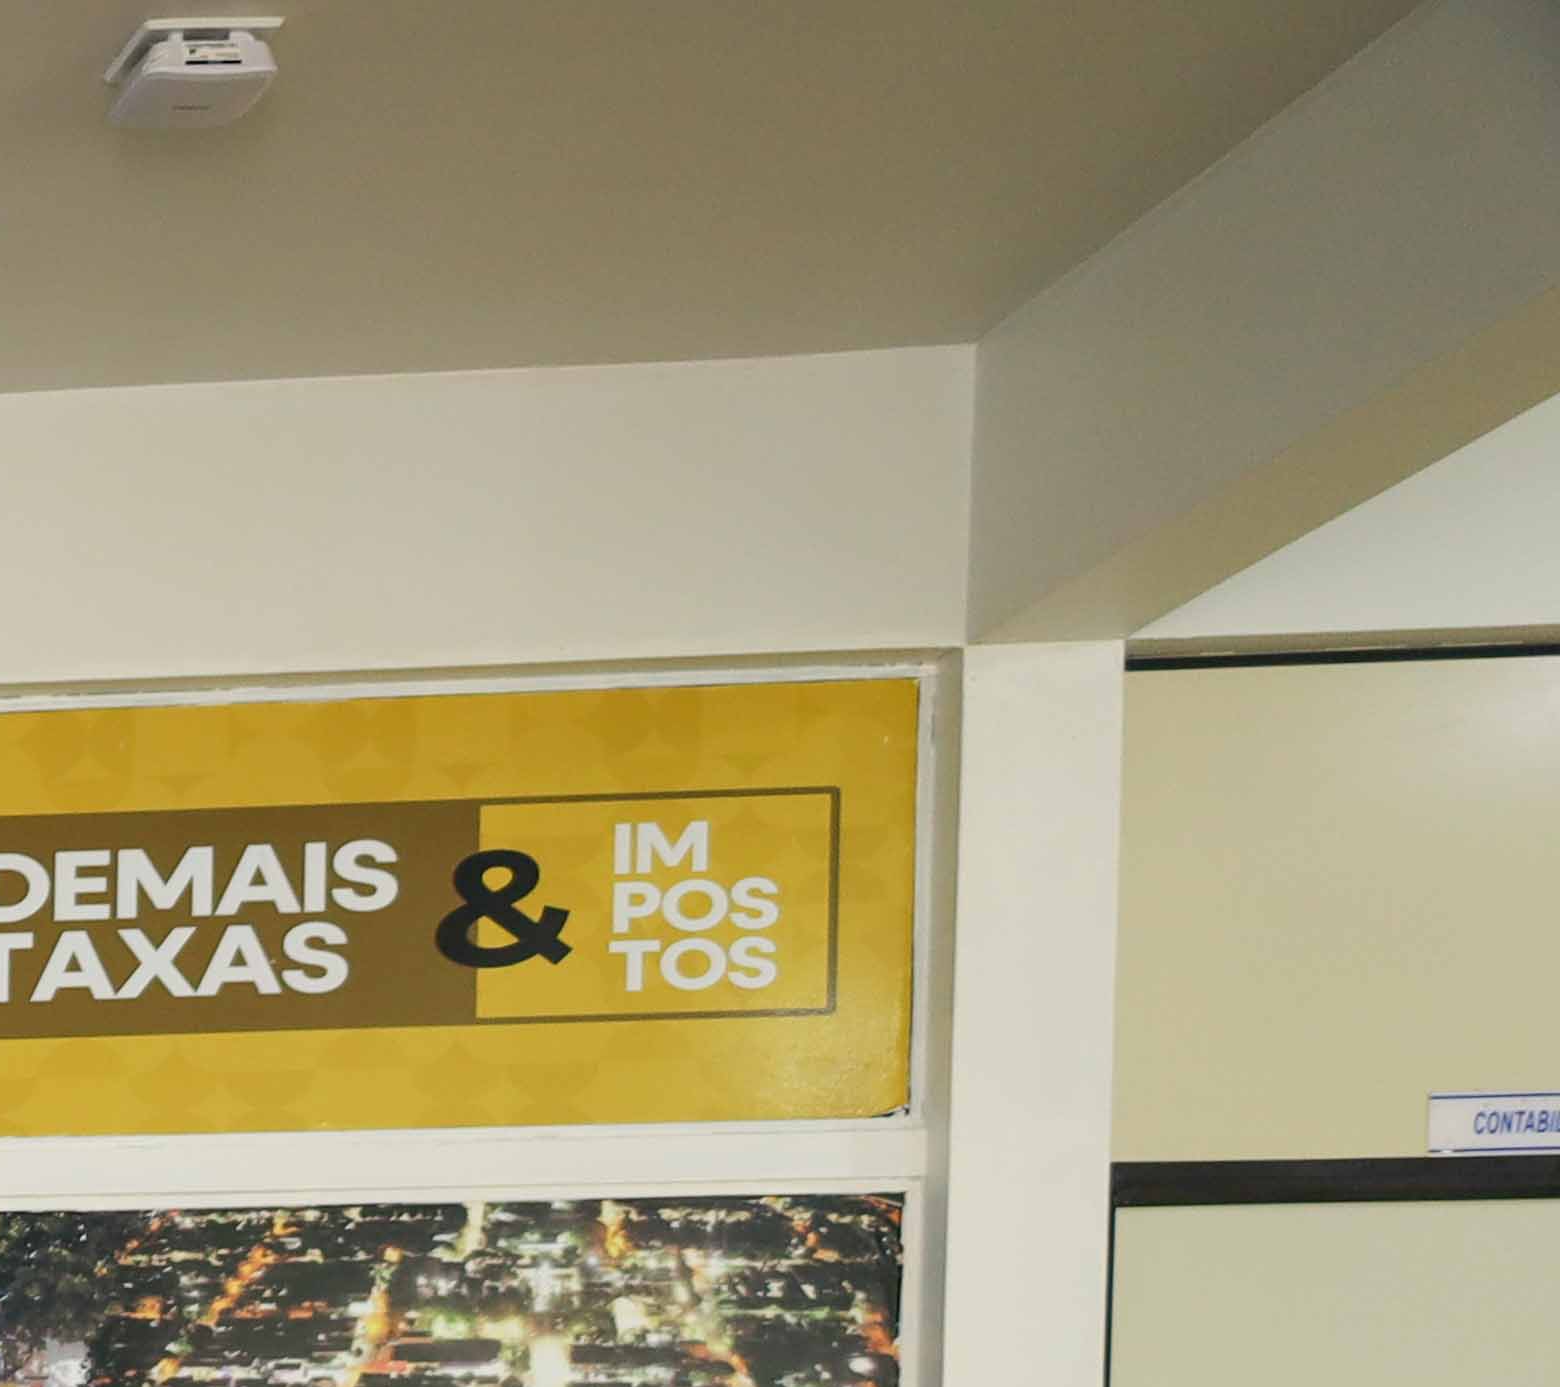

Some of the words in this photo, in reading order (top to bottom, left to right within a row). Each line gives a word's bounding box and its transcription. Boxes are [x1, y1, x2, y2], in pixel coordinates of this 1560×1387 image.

[611, 820, 708, 876] IM
[434, 849, 573, 968] &
[611, 876, 779, 933] POS
[608, 935, 778, 992] TOS
